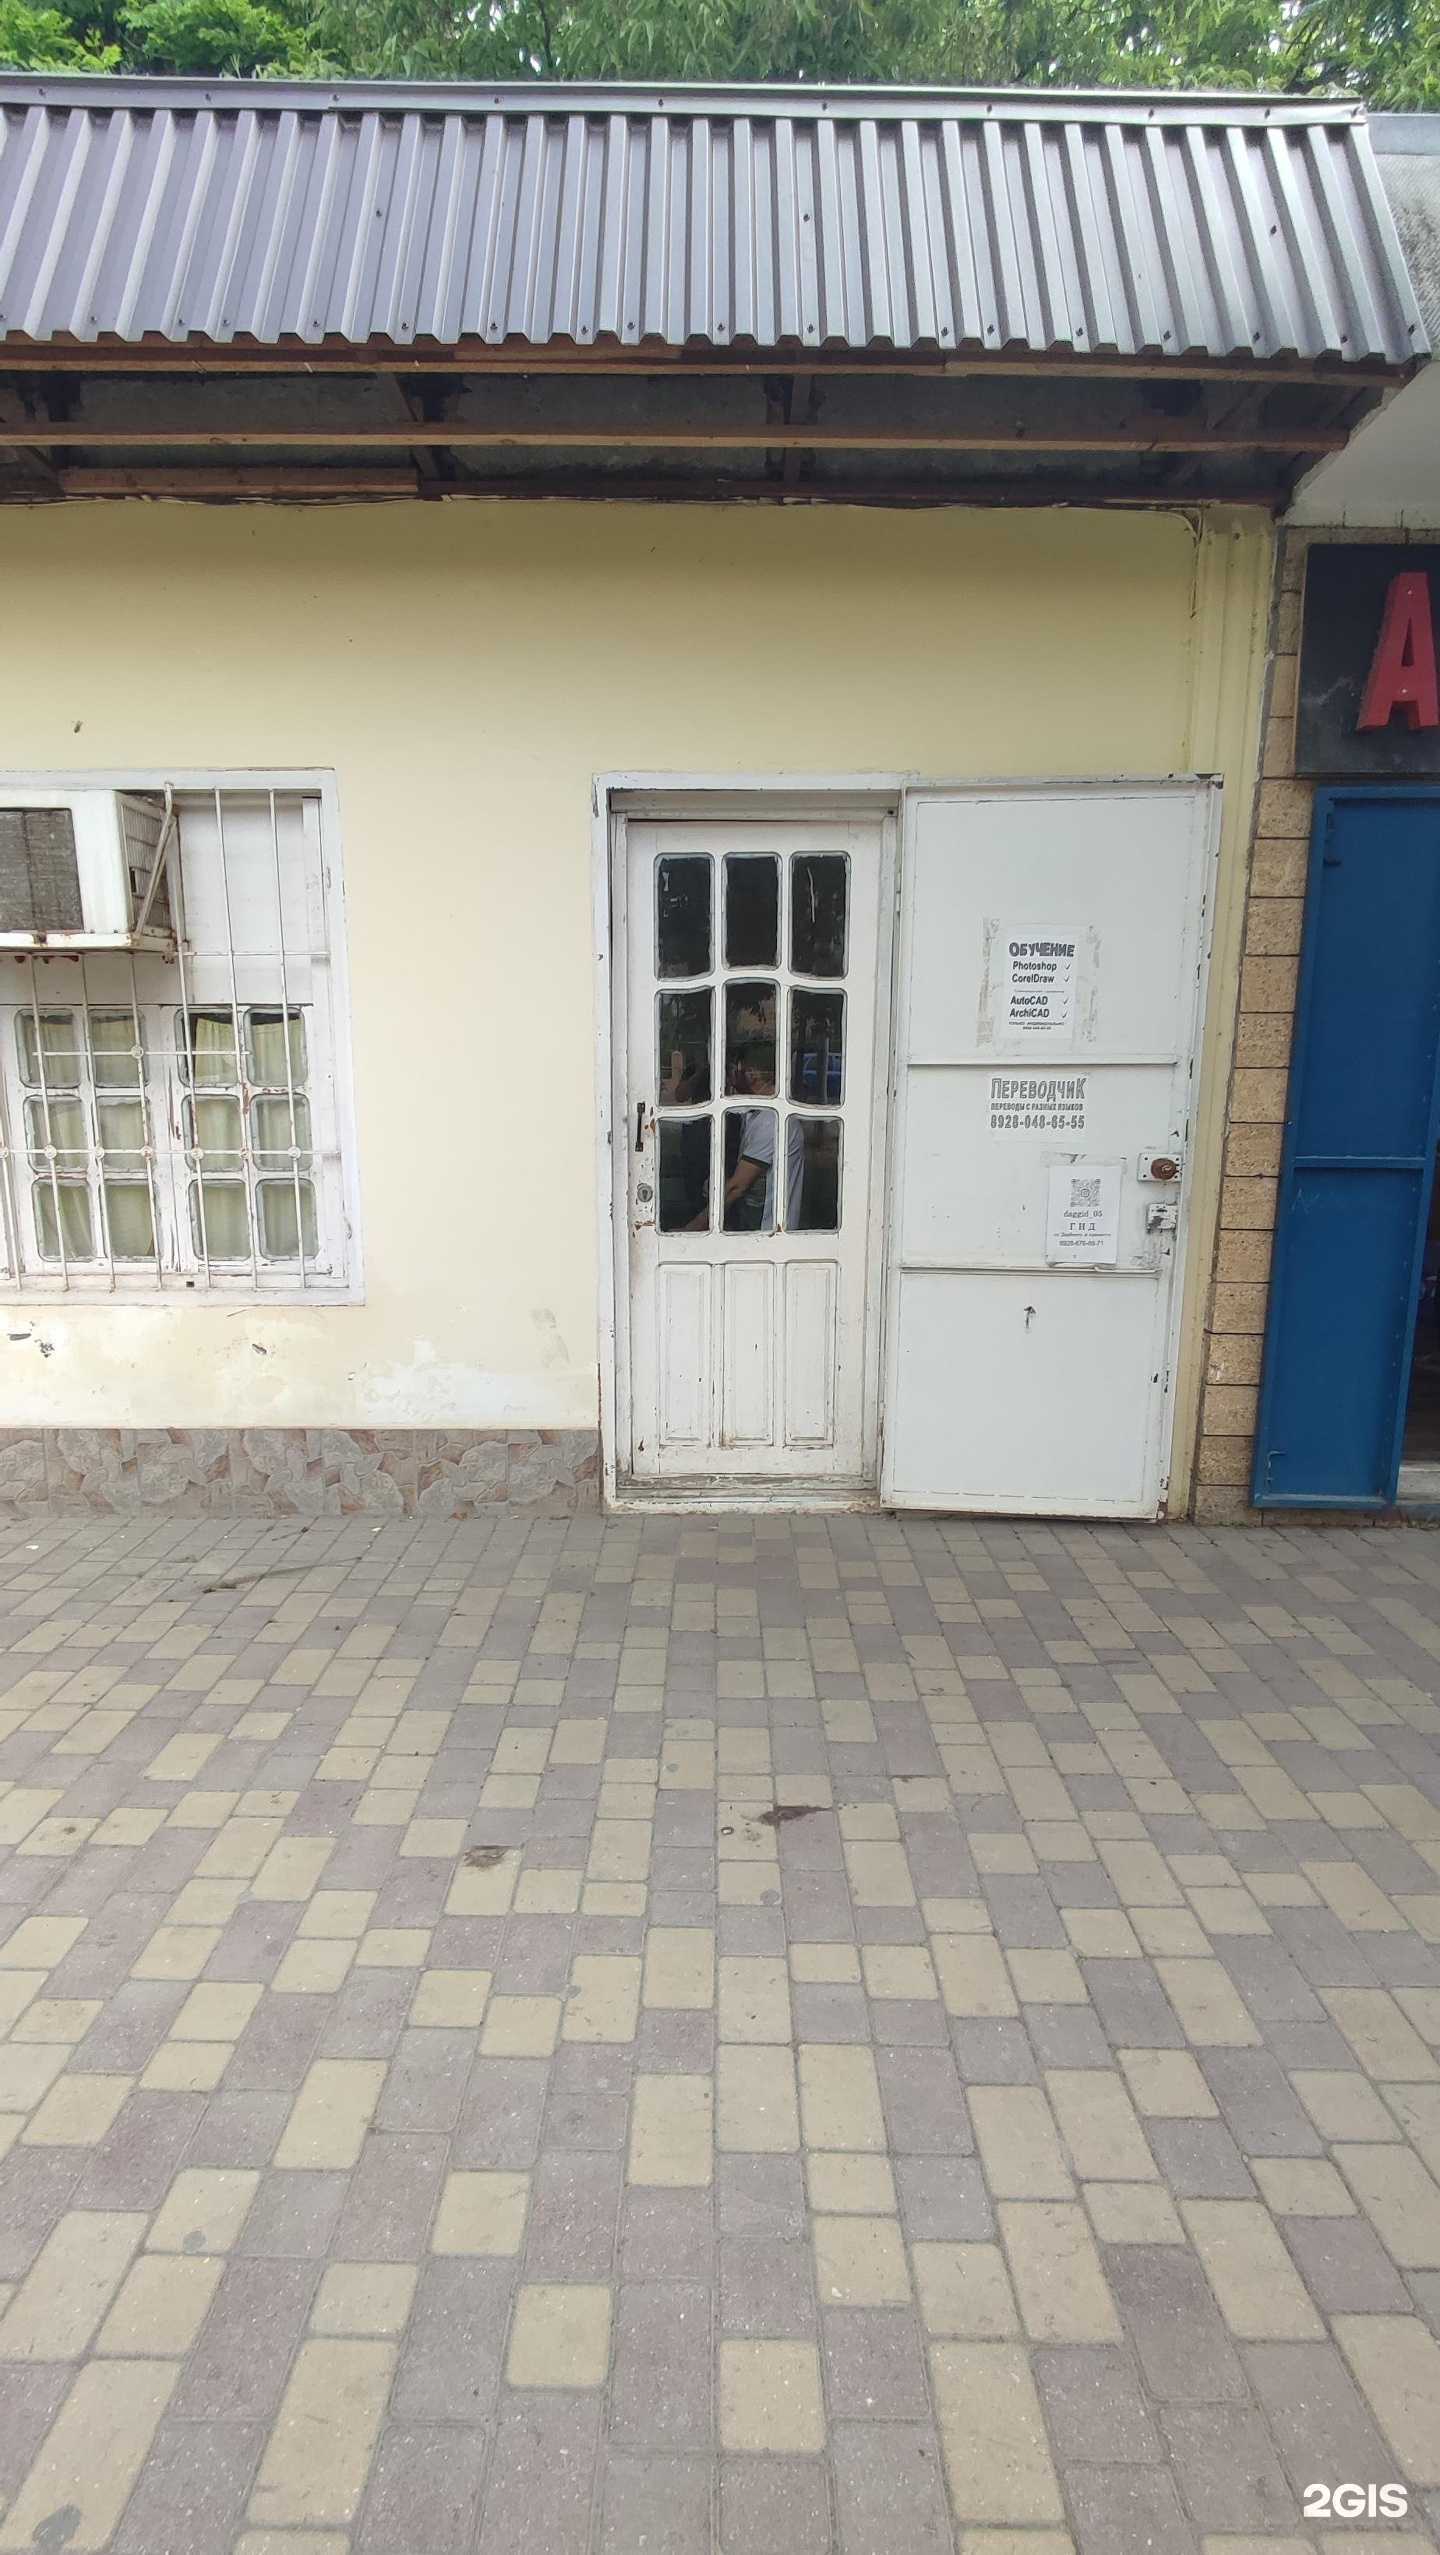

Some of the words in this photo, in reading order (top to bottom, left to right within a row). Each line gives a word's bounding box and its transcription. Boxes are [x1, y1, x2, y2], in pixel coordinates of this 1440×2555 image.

[1009, 942, 1075, 957] ОБУЧЕНИЕ
[1012, 961, 1057, 972] Photoshop
[1012, 974, 1055, 983] CorelDraw
[1010, 996, 1048, 1005] AutoCAD
[1009, 1008, 1050, 1018] ArchiCAD
[991, 1077, 1087, 1102] ПЕРЕВОДЧИК
[991, 1103, 1025, 1111] ПЕРЕВОДЫ
